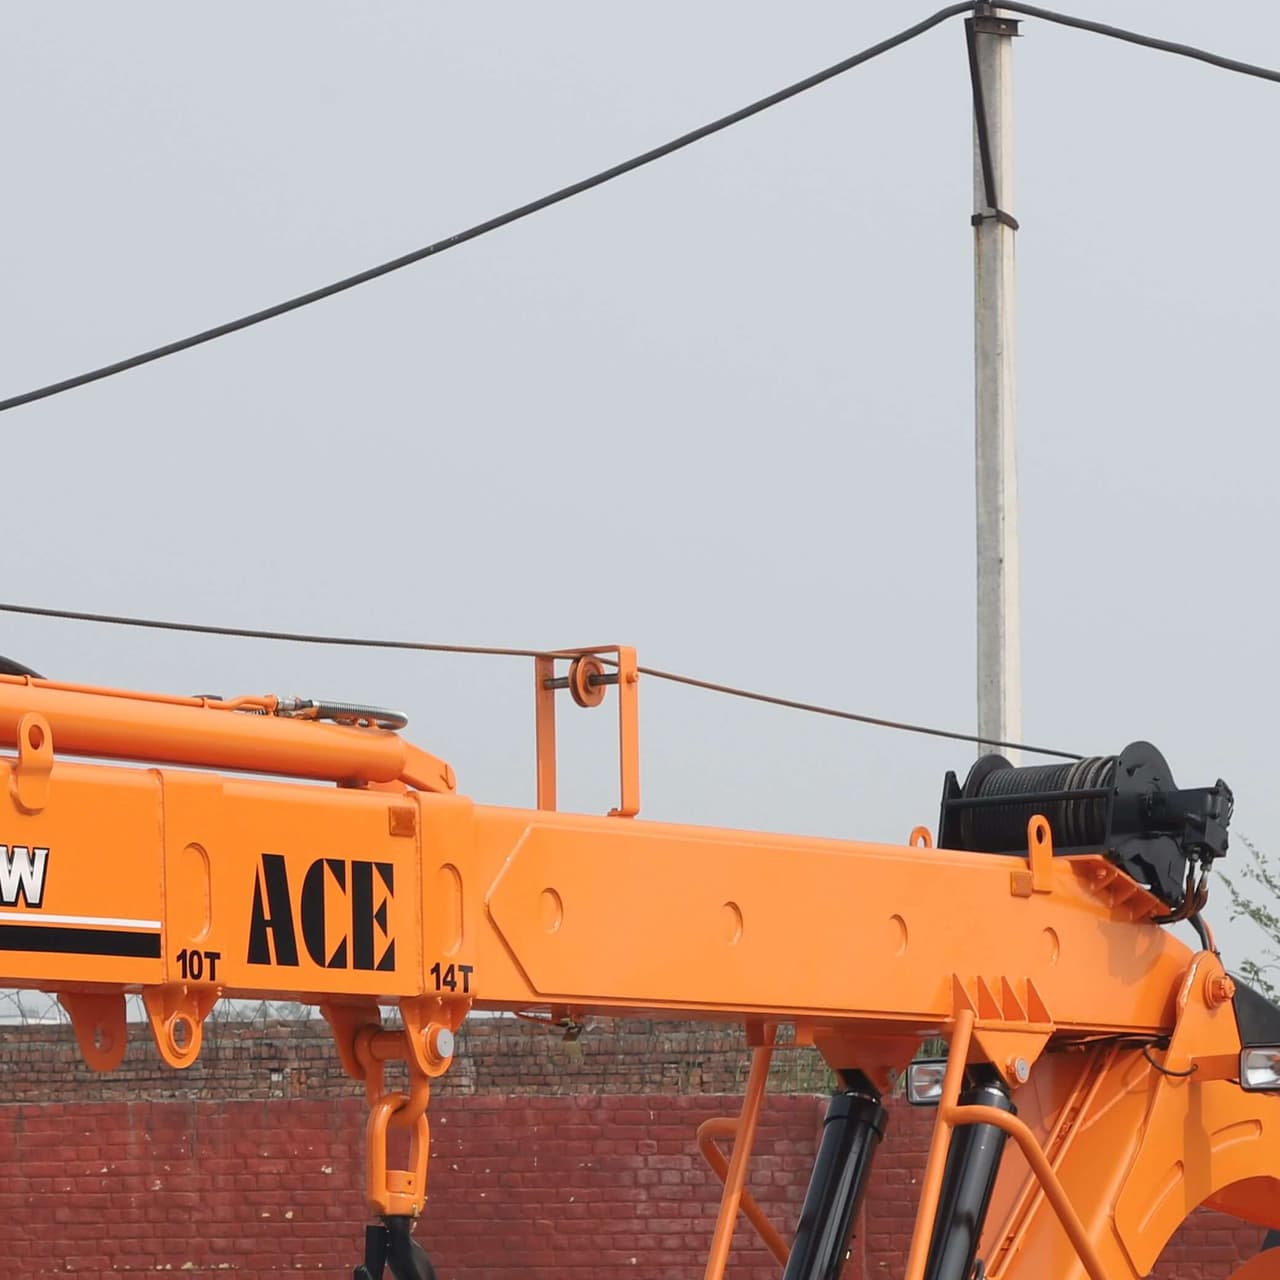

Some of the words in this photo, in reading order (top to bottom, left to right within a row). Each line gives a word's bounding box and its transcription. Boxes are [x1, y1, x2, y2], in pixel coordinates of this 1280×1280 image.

[247, 853, 395, 972] ACE
[176, 949, 221, 981] 10T
[431, 963, 474, 993] 14T
